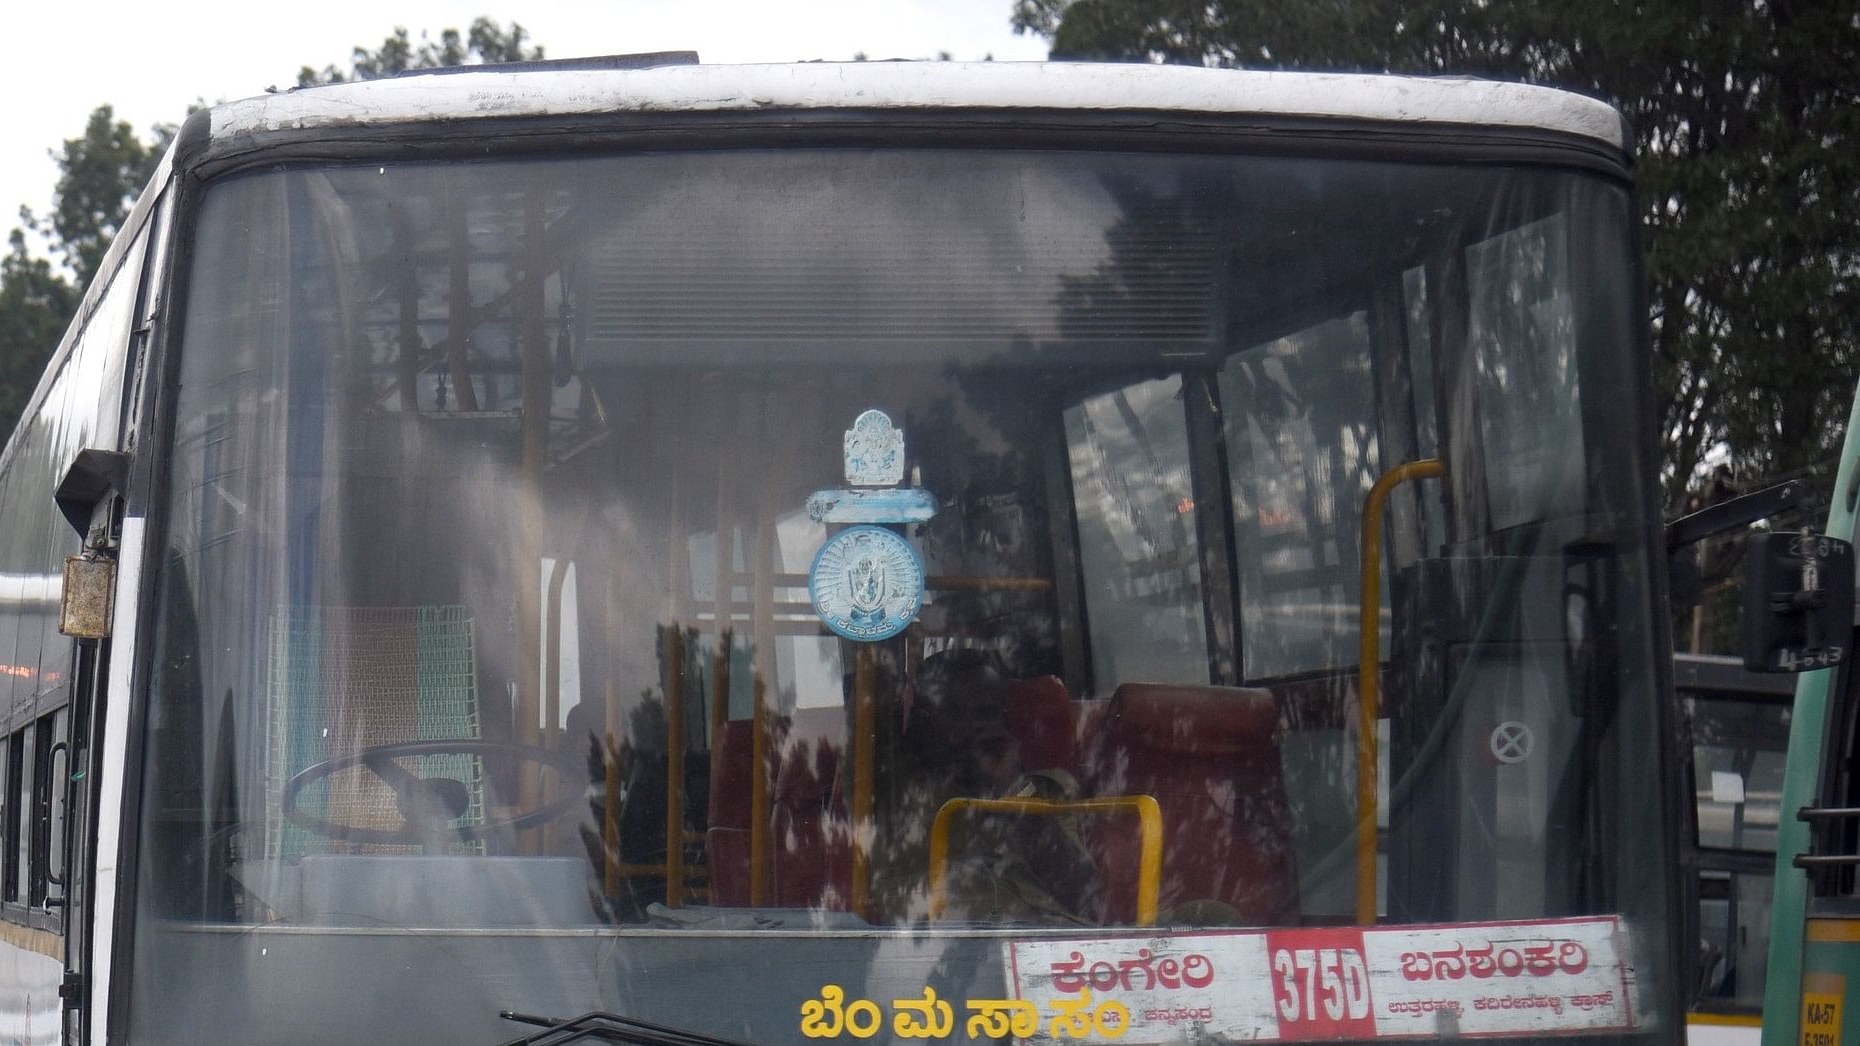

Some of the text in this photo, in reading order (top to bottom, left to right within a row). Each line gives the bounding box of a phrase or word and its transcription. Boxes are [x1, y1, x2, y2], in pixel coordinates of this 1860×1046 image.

[1051, 948, 1215, 993] ಕೆಂಗೇರಿ
[1273, 947, 1372, 1023] 375D
[1400, 938, 1589, 982] ಬನಶಂಕರಿ
[800, 984, 1131, 1040] ಬೆಂ ಮ ಸಾ ಸಂ
